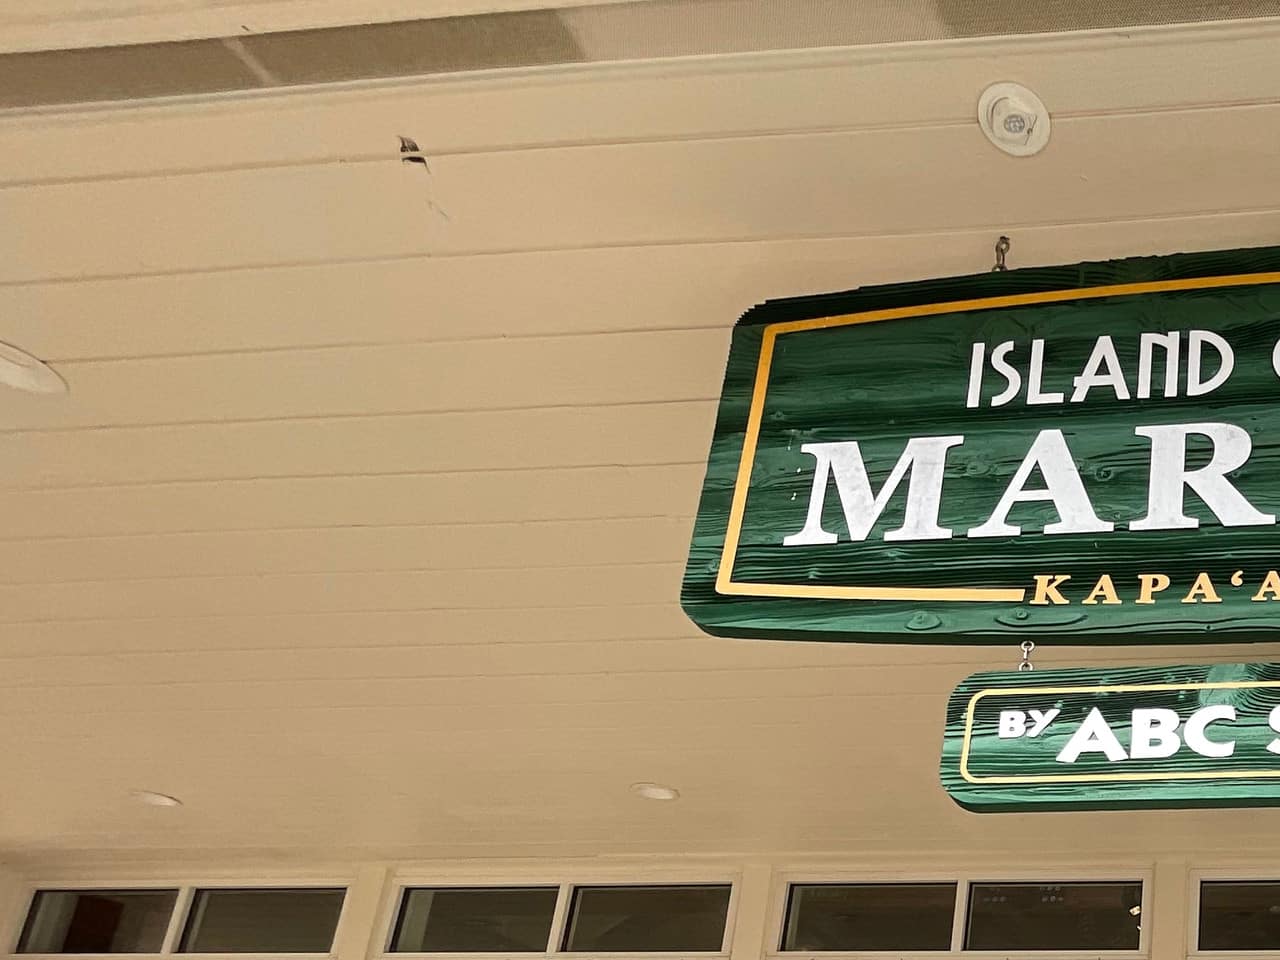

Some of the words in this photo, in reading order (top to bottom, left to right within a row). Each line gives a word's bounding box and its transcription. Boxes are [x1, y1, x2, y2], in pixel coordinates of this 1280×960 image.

[966, 331, 1235, 408] ISLAND
[998, 708, 1061, 739] BY
[1055, 703, 1237, 763] ABC
